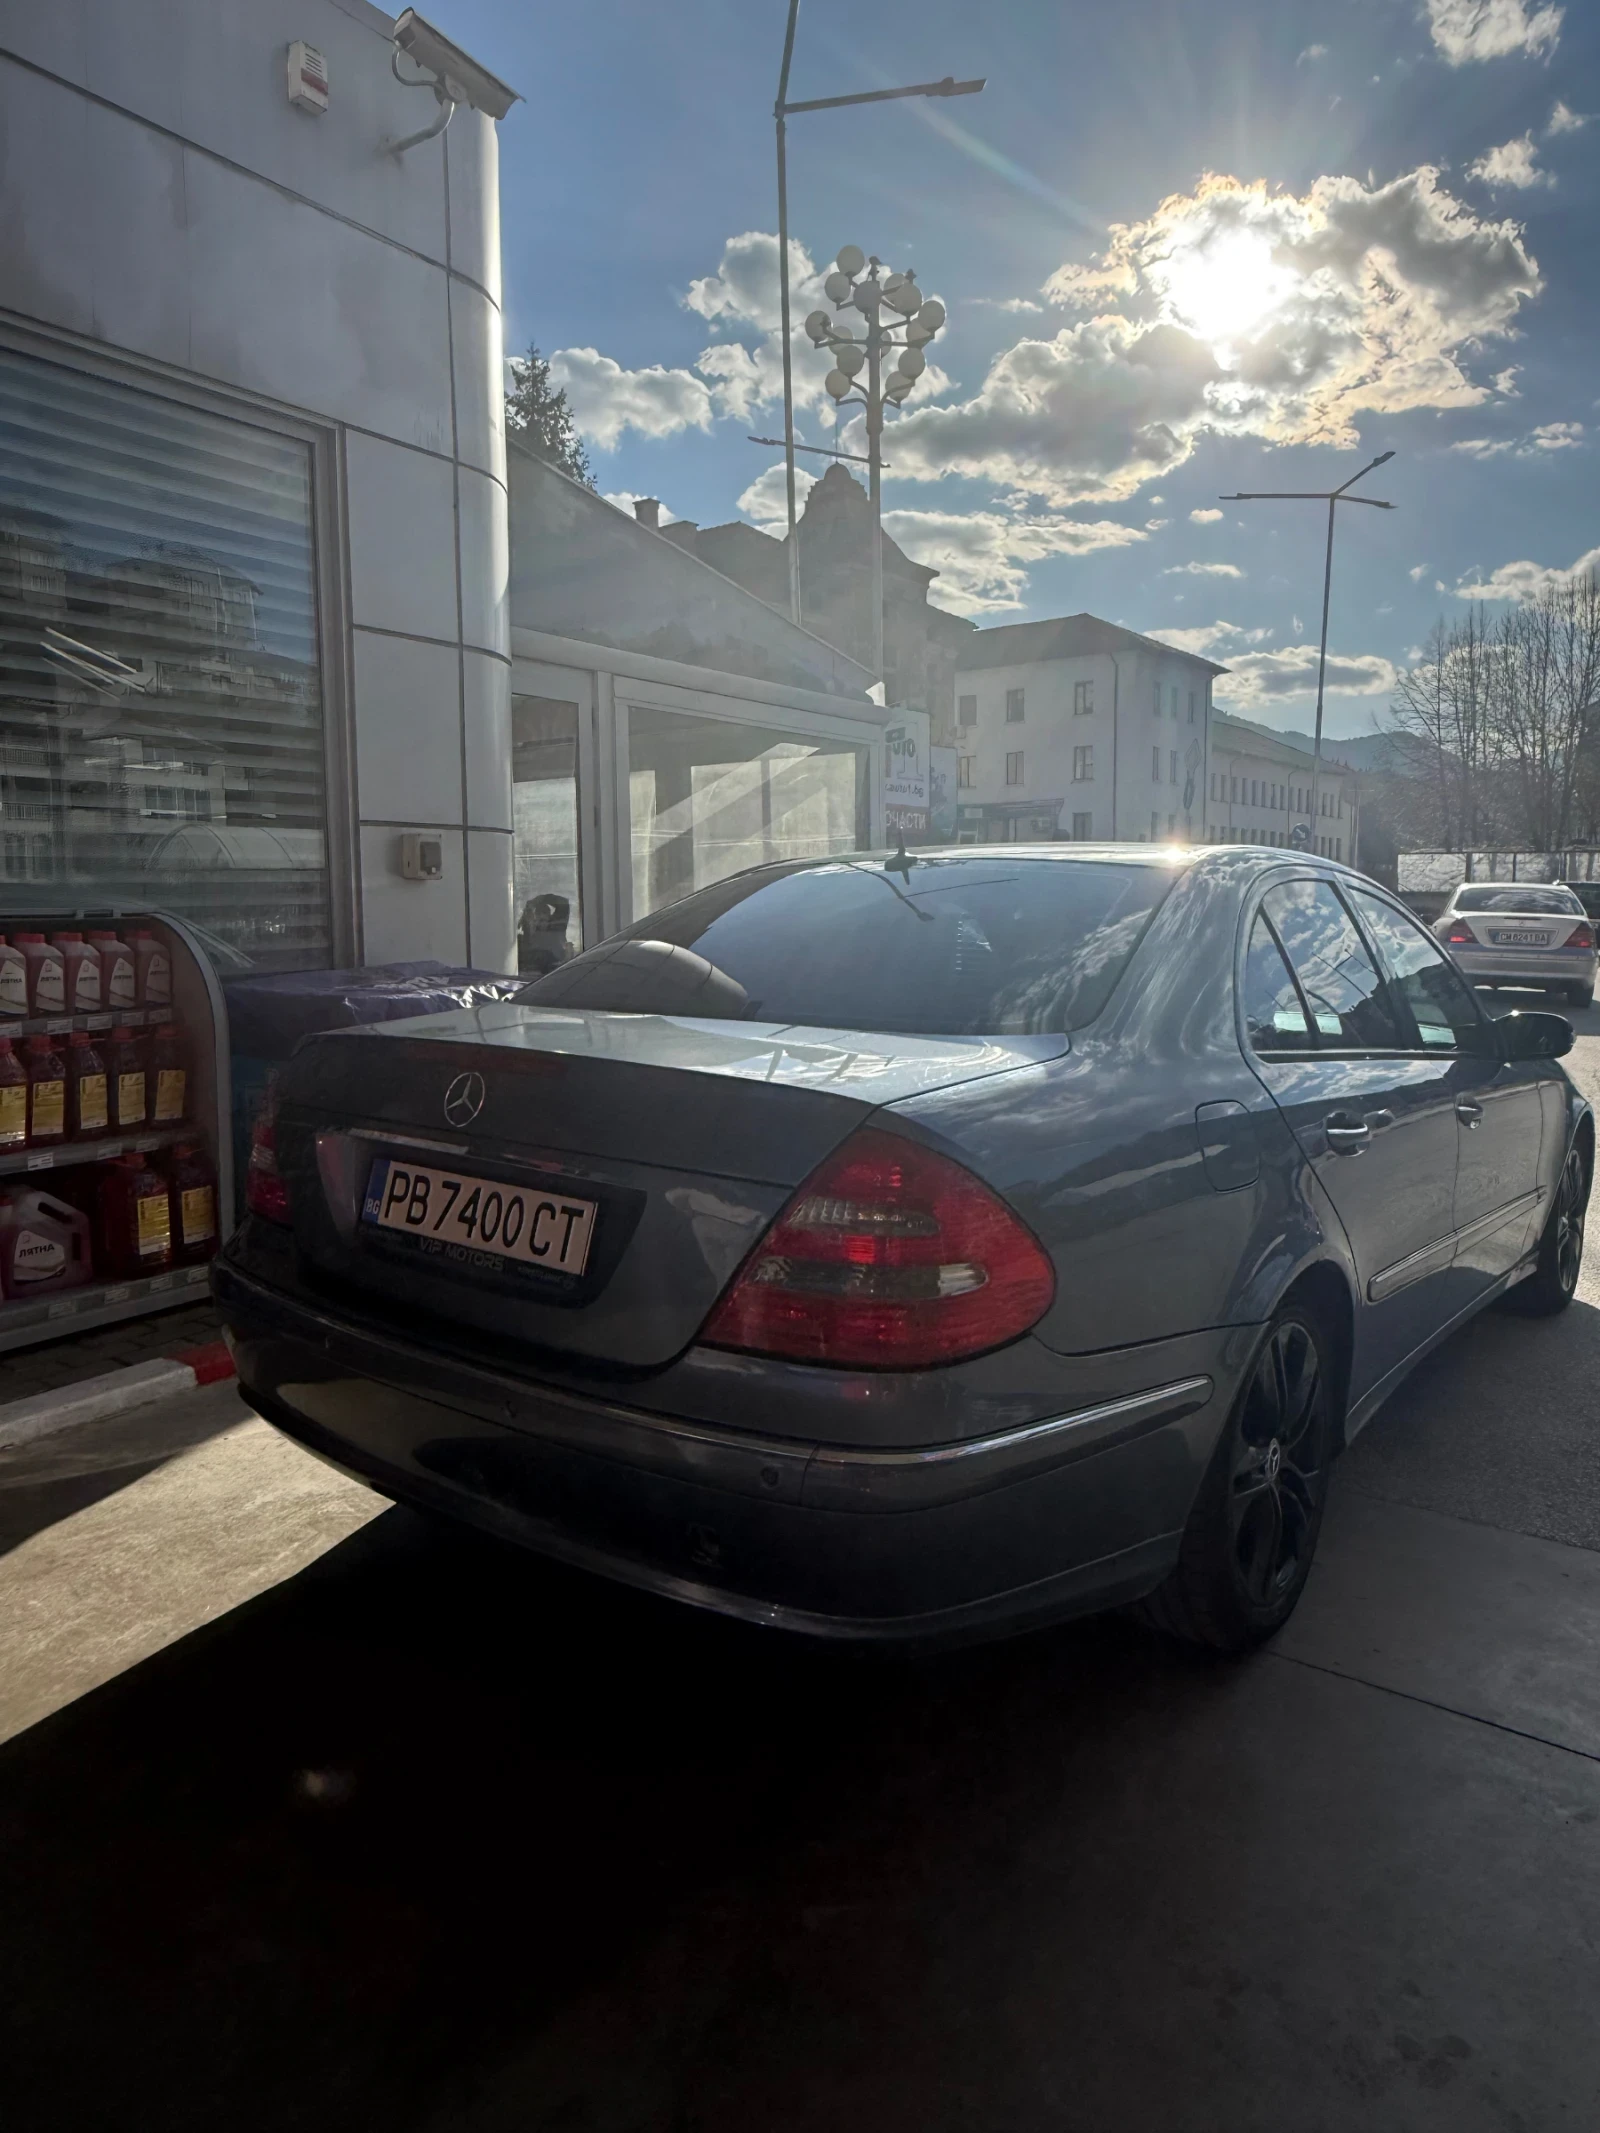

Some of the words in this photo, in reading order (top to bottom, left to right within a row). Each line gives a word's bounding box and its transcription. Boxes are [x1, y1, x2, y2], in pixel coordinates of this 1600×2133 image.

[366, 1197, 381, 1214] BG
[384, 1170, 431, 1225] PB
[433, 1181, 524, 1248] 7400
[529, 1201, 585, 1263] CT
[18, 1243, 55, 1258] ЛЯТНА
[418, 1239, 443, 1255] VIP
[445, 1245, 505, 1271] MOTORS
